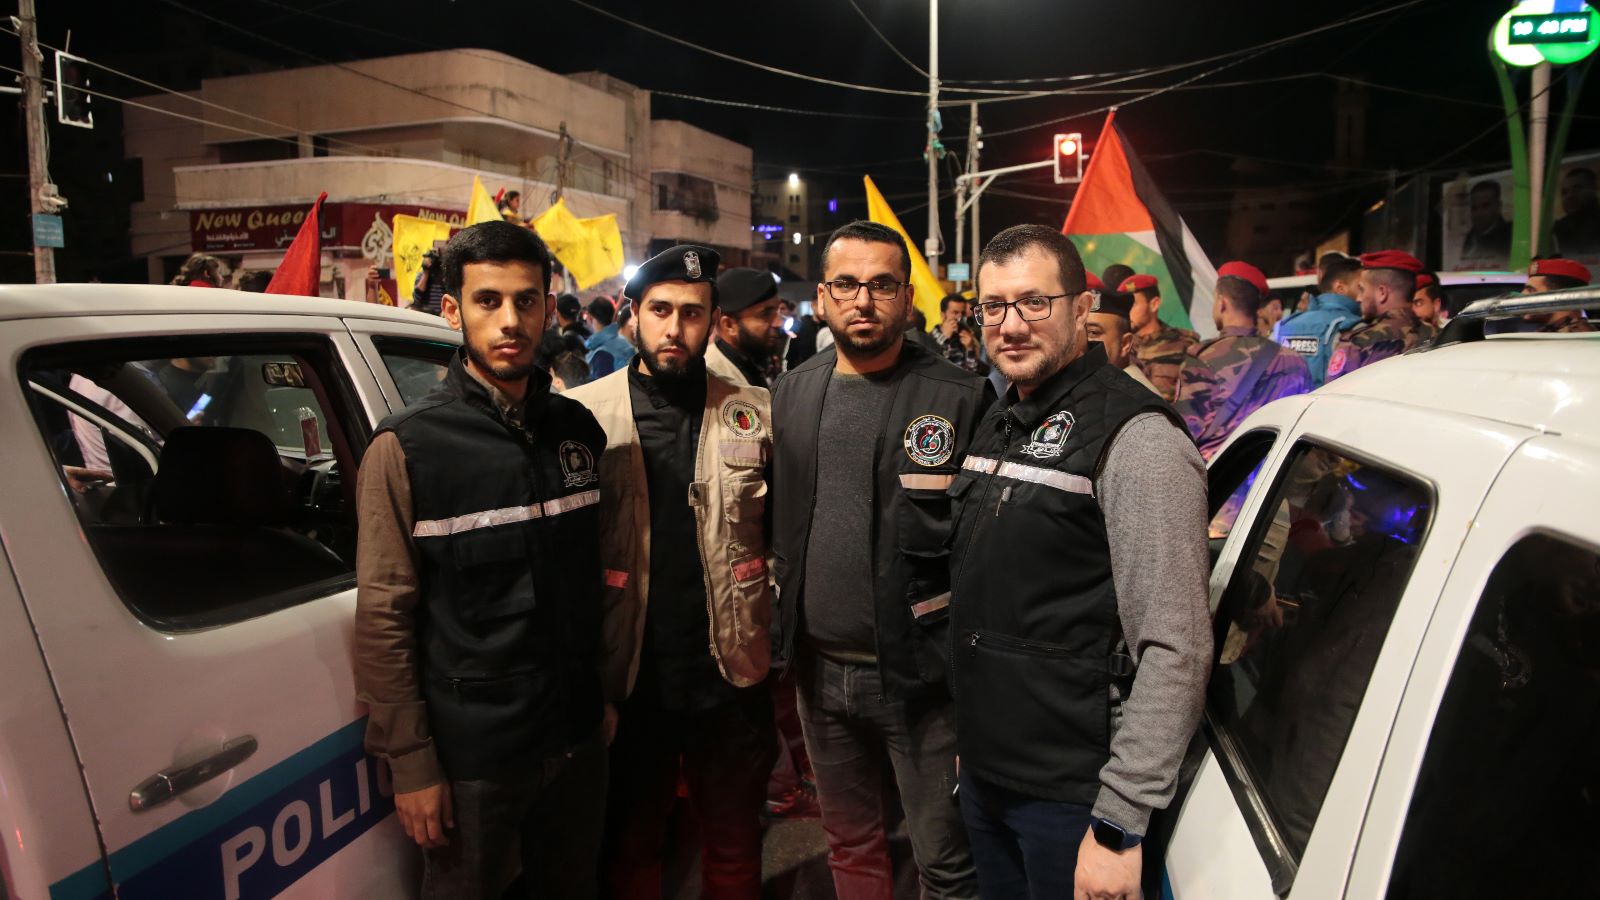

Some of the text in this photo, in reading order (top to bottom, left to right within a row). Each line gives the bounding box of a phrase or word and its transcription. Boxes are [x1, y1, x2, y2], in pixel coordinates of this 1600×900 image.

[195, 210, 310, 231] New Quee
[1290, 339, 1317, 352] PRESS
